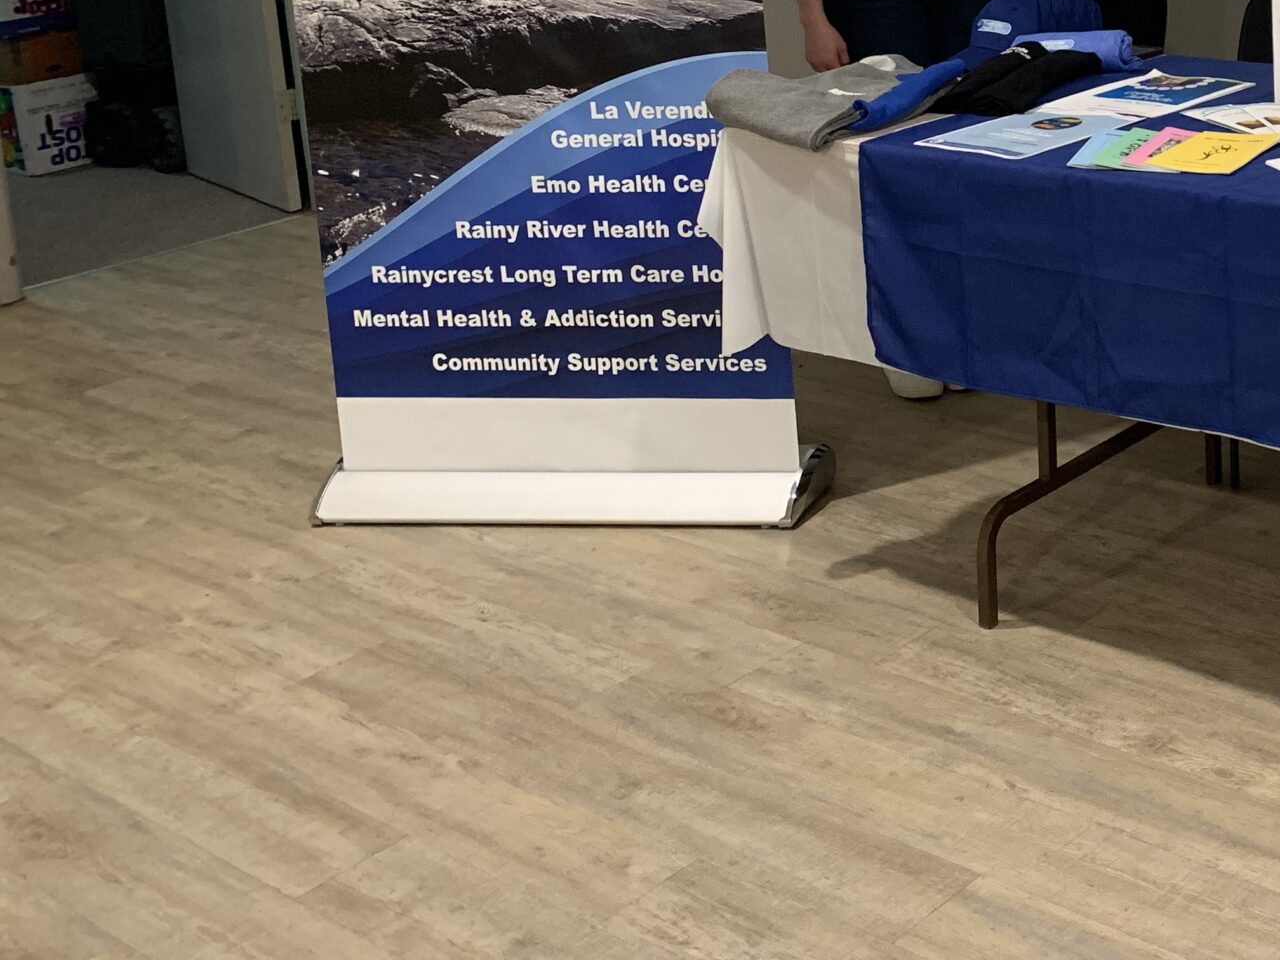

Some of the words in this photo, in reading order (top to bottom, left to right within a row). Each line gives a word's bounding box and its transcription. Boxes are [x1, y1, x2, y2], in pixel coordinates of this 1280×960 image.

[590, 101, 618, 120] La
[624, 100, 714, 120] Verend
[550, 129, 643, 149] General
[651, 128, 722, 152] Hospi
[531, 176, 580, 194] Emo
[588, 174, 665, 194] Health
[456, 221, 519, 242] Rainy
[526, 220, 586, 239] River
[593, 219, 669, 239] Health
[371, 265, 493, 288] Rainycrest
[500, 265, 556, 288] Long
[563, 265, 623, 284] Term
[630, 265, 685, 283] Care
[692, 264, 724, 283] Ho
[353, 309, 430, 328] Mental
[437, 309, 511, 328] Health
[519, 309, 537, 328] &
[544, 308, 654, 328] Addiction
[661, 308, 722, 328] Servi
[432, 354, 560, 377] Community
[567, 353, 659, 376] Support
[665, 353, 767, 373] Services
